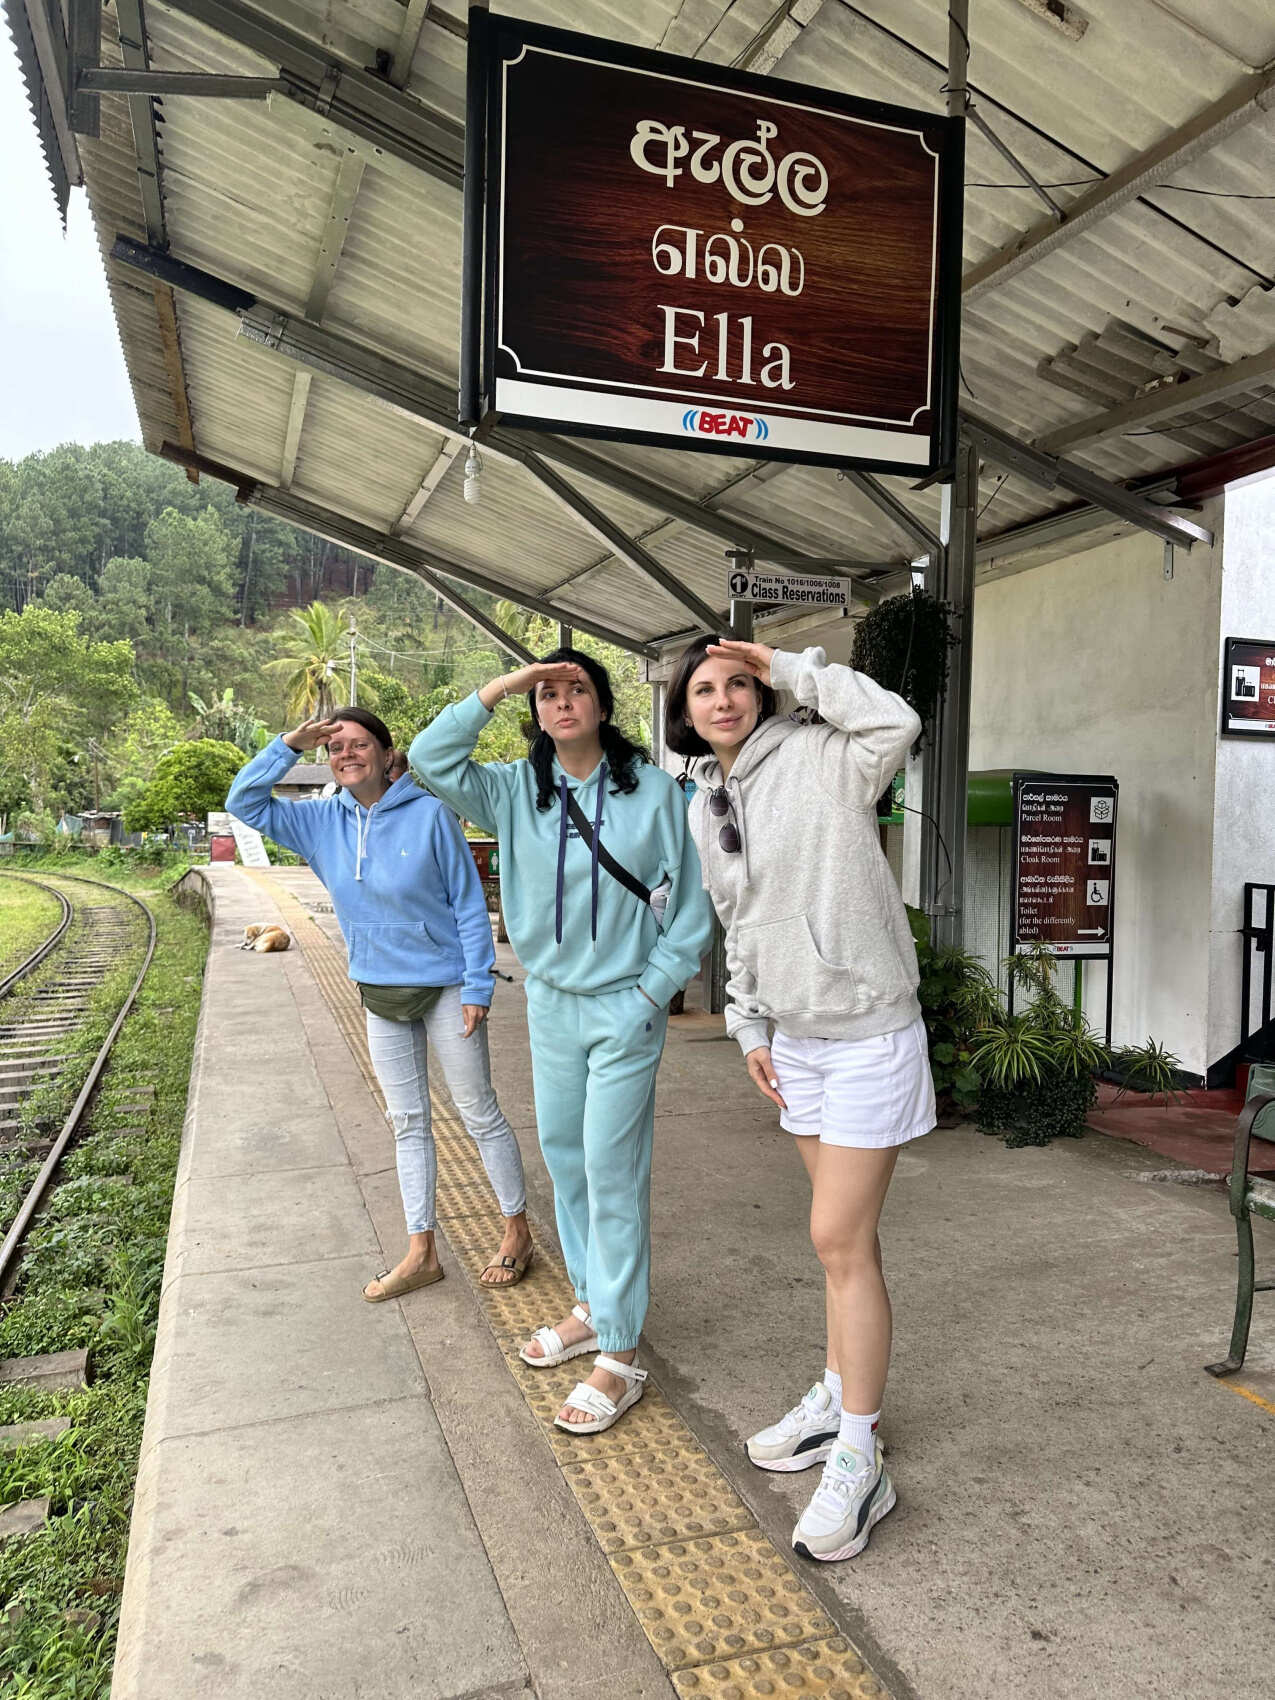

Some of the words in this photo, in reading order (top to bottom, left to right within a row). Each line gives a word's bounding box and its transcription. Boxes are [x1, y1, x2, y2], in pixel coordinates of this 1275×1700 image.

[629, 119, 829, 217] ඇල්ල
[652, 218, 805, 297] எல்ல
[655, 304, 797, 391] Ella
[698, 411, 754, 438] BEAT
[754, 575, 773, 584] Train
[774, 577, 785, 585] No
[751, 583, 779, 600] Class
[781, 585, 846, 604] Reservations
[1022, 814, 1041, 822] Parcel
[1043, 814, 1062, 822] Room
[1020, 855, 1040, 863] Cloak
[1019, 906, 1038, 914] Toilet
[1019, 917, 1031, 925] (for
[1043, 916, 1076, 926] differently
[1019, 927, 1039, 935] abled)
